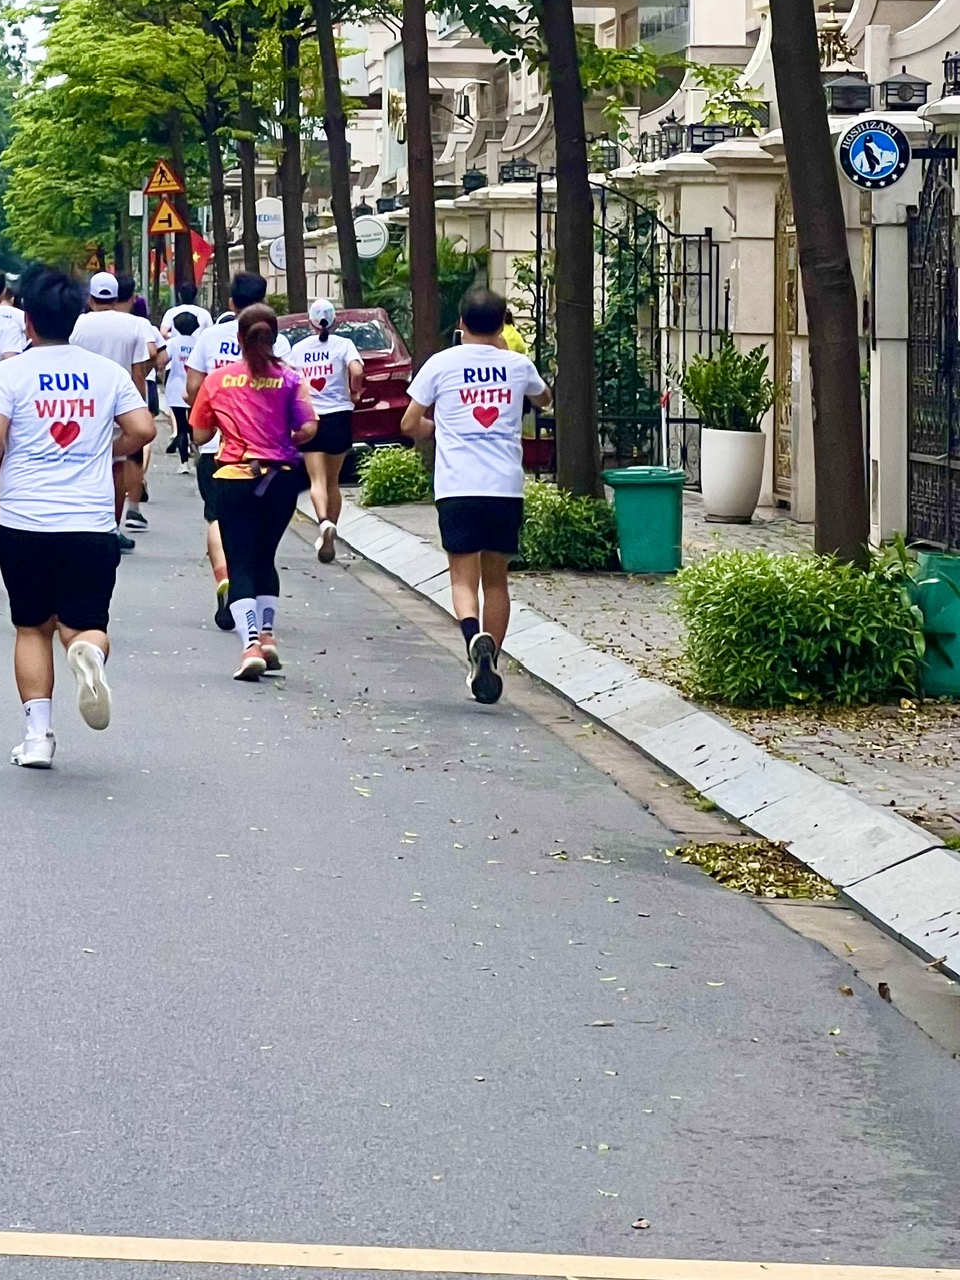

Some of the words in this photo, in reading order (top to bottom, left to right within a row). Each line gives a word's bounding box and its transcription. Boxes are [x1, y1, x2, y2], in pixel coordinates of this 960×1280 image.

[841, 121, 898, 150] HOSHIZAKI
[220, 342, 241, 356] RU
[304, 351, 329, 363] RUN
[302, 363, 333, 378] WITH
[463, 366, 507, 383] RUN
[39, 372, 89, 391] RUN
[459, 388, 511, 404] WITH
[35, 398, 95, 418] WITH
